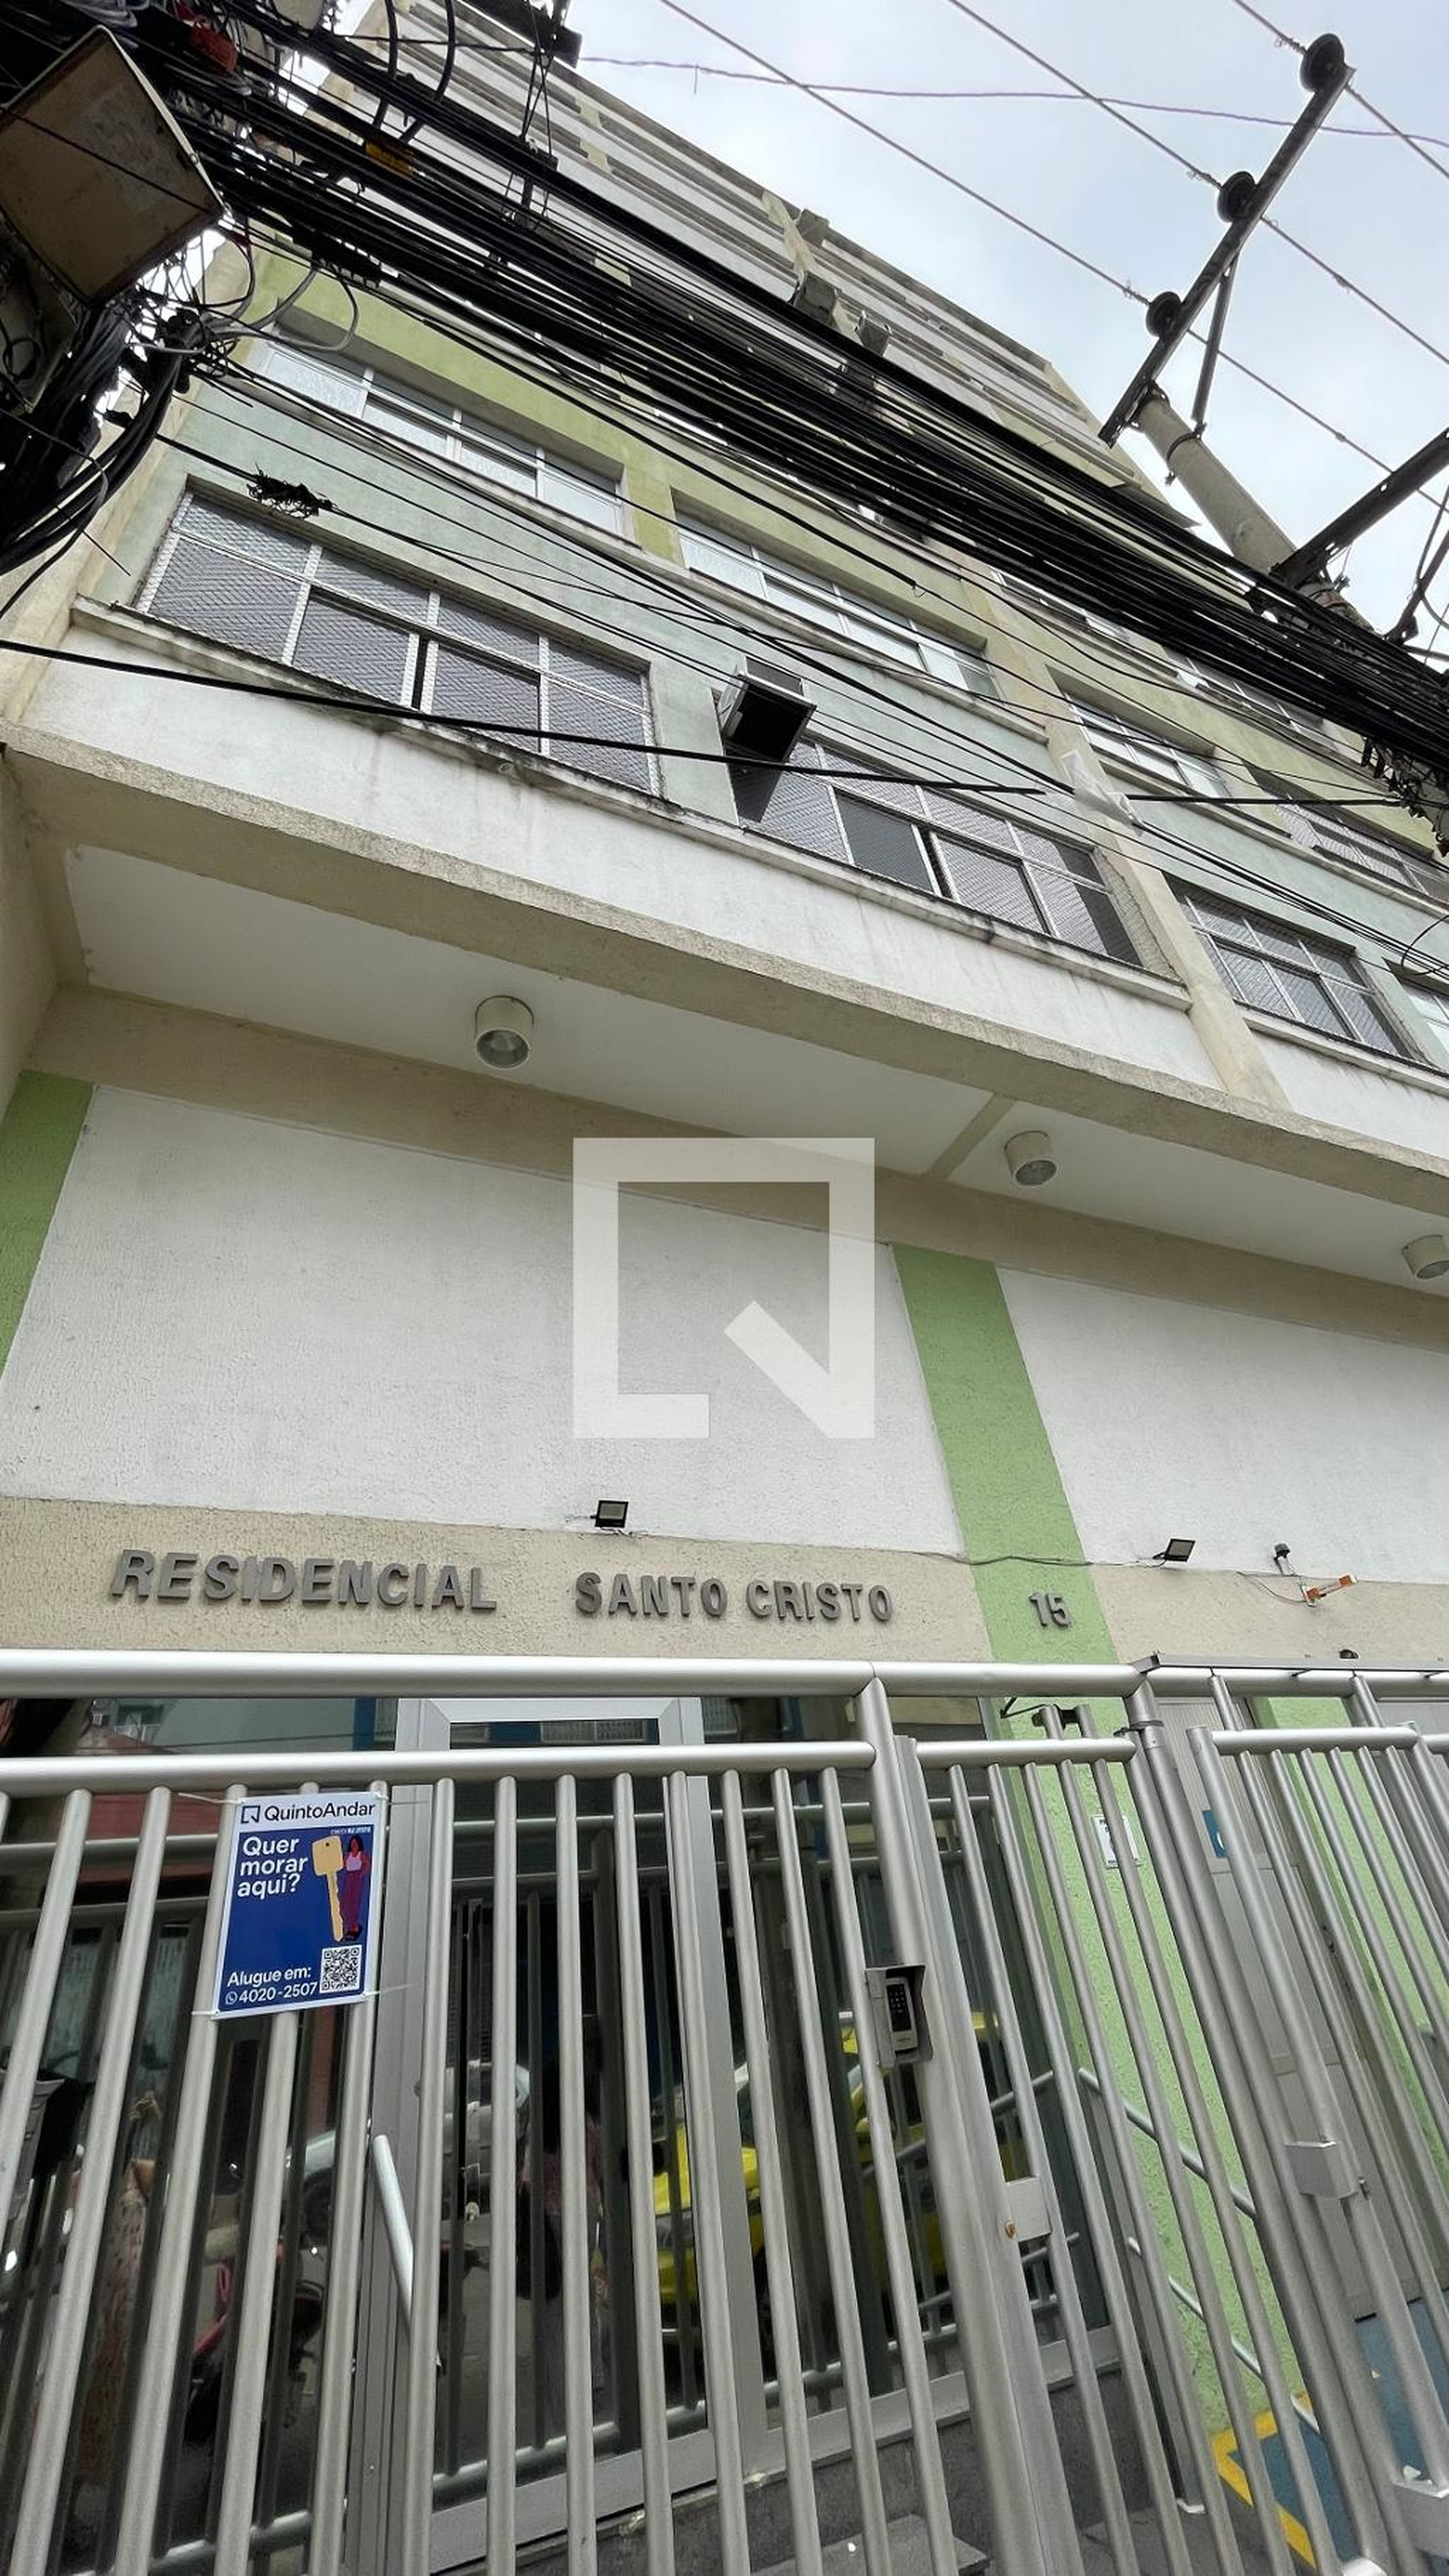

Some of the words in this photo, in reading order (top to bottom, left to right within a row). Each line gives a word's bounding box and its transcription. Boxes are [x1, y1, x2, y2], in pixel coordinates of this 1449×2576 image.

[111, 1549, 497, 1610] RESIDENCIAL
[574, 1571, 728, 1617] SANTO
[746, 1580, 894, 1622] CRISTO
[1028, 1591, 1072, 1628] 15
[265, 1802, 375, 1821] QuintoAndar
[243, 1836, 299, 1856] Quer
[240, 1857, 308, 1876] morar
[237, 1874, 301, 1900] aqui?
[227, 1969, 282, 1988] Alugue
[284, 1967, 311, 1980] em:
[239, 1982, 318, 2003] 4020-2507
